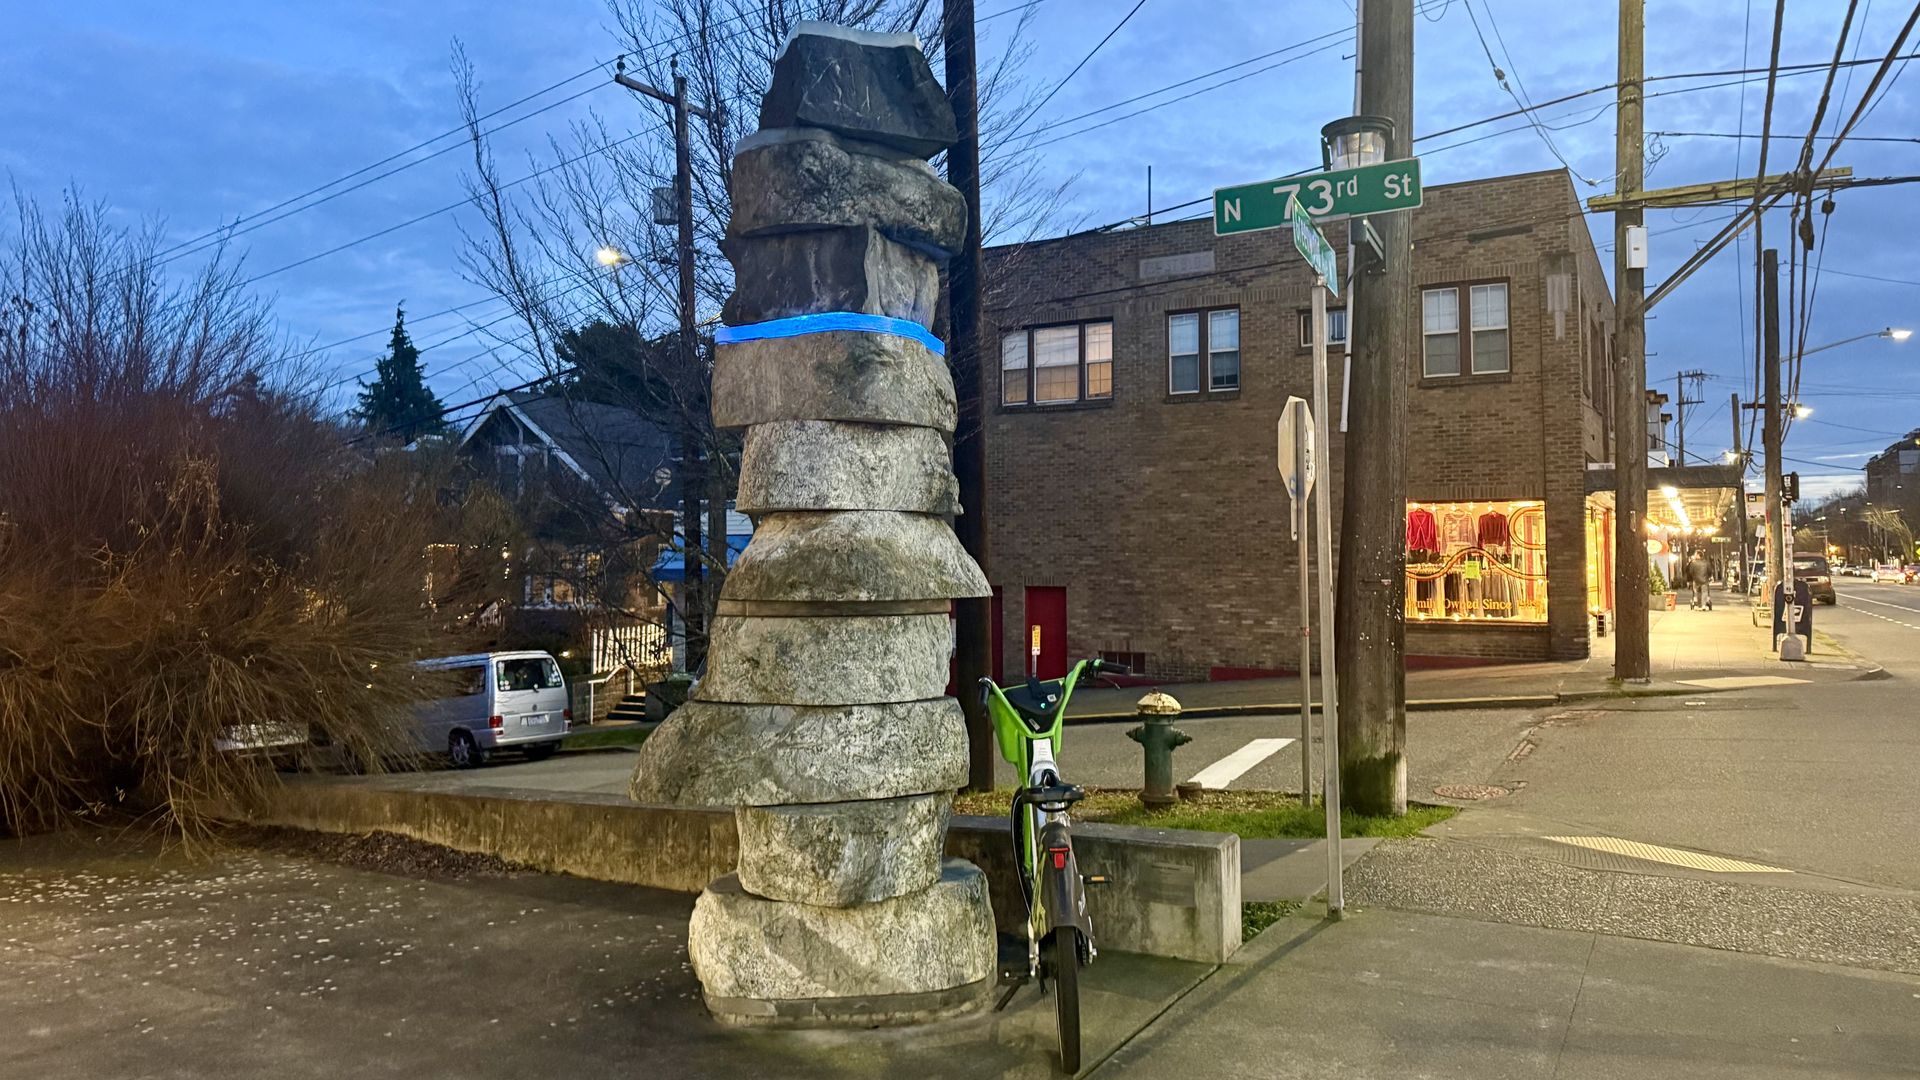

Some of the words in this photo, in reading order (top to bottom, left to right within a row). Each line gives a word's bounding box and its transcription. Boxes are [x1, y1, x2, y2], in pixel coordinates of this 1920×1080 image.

[1223, 197, 1241, 223] N
[1273, 174, 1358, 220] 73rd
[1383, 172, 1412, 199] St
[1482, 598, 1513, 610] Since
